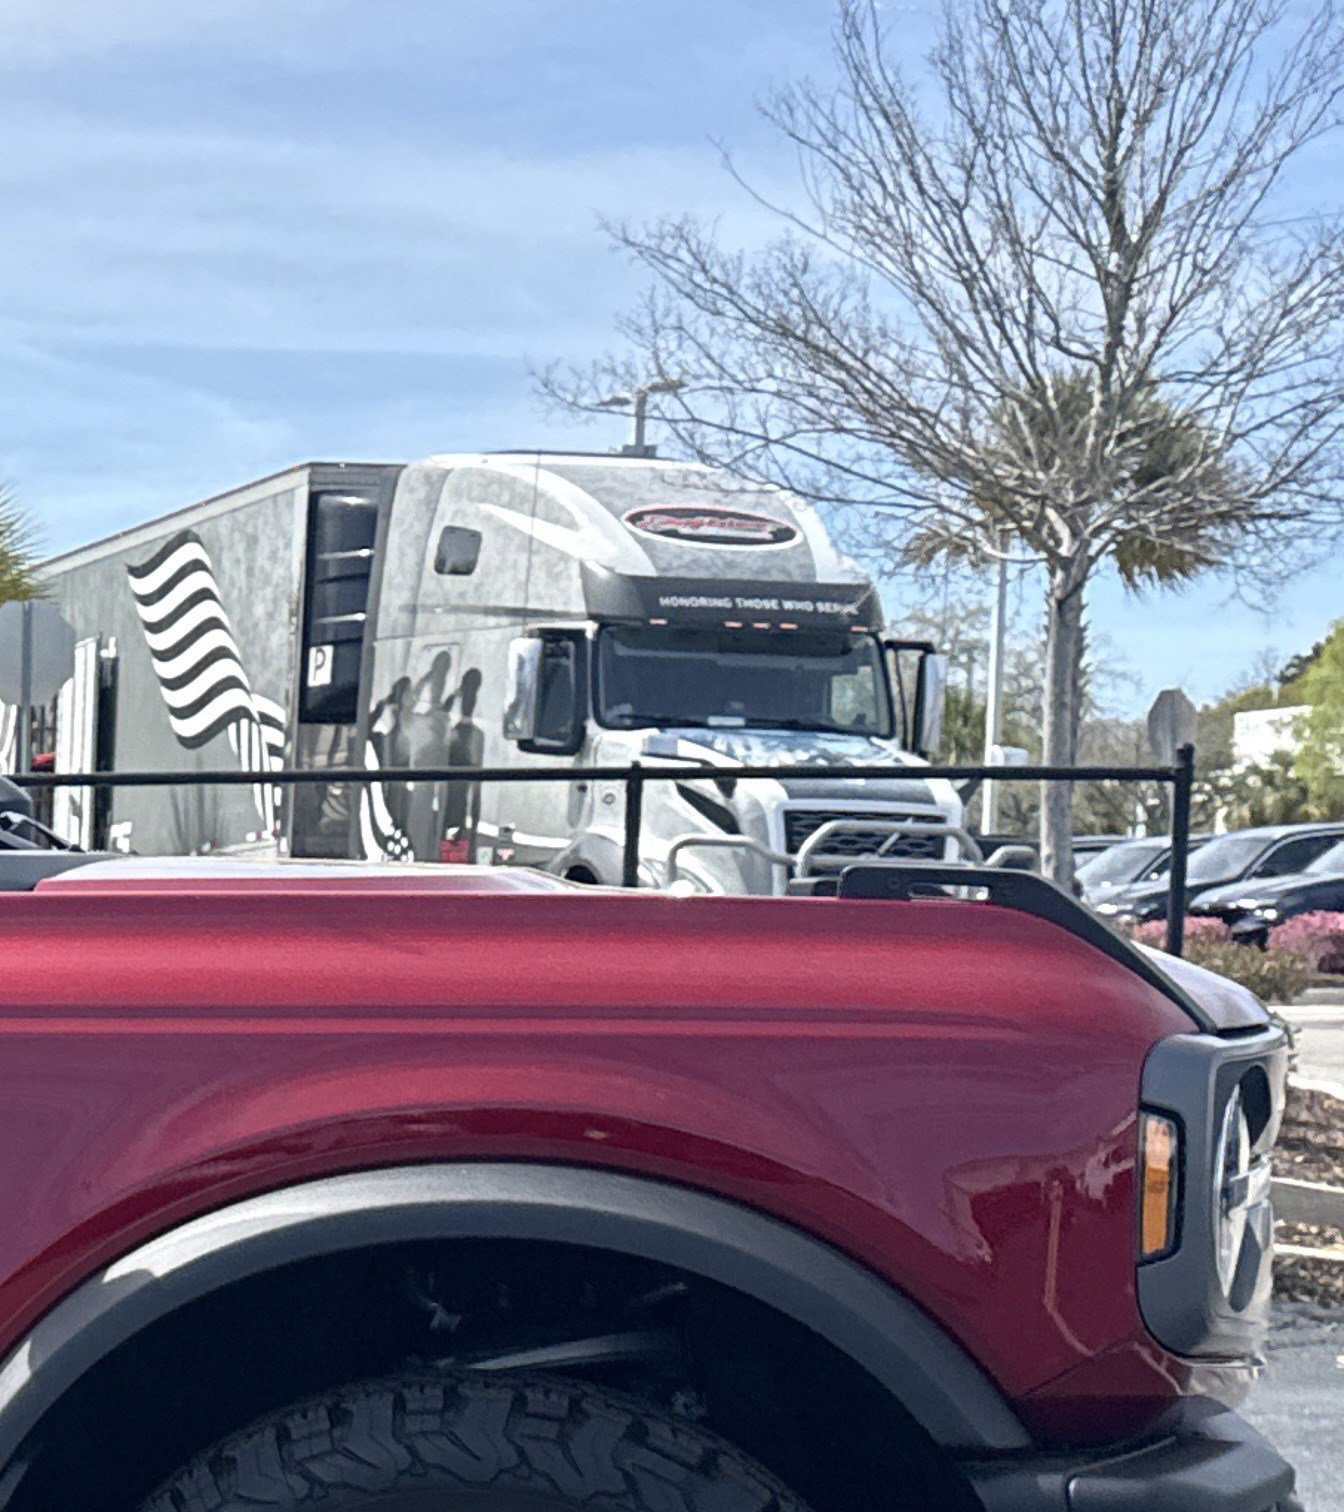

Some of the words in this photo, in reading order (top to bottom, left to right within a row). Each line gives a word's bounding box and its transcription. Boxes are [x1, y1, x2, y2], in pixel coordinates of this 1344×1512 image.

[658, 596, 733, 609] HONORING
[735, 597, 780, 611] THOSE
[781, 600, 814, 612] WHO
